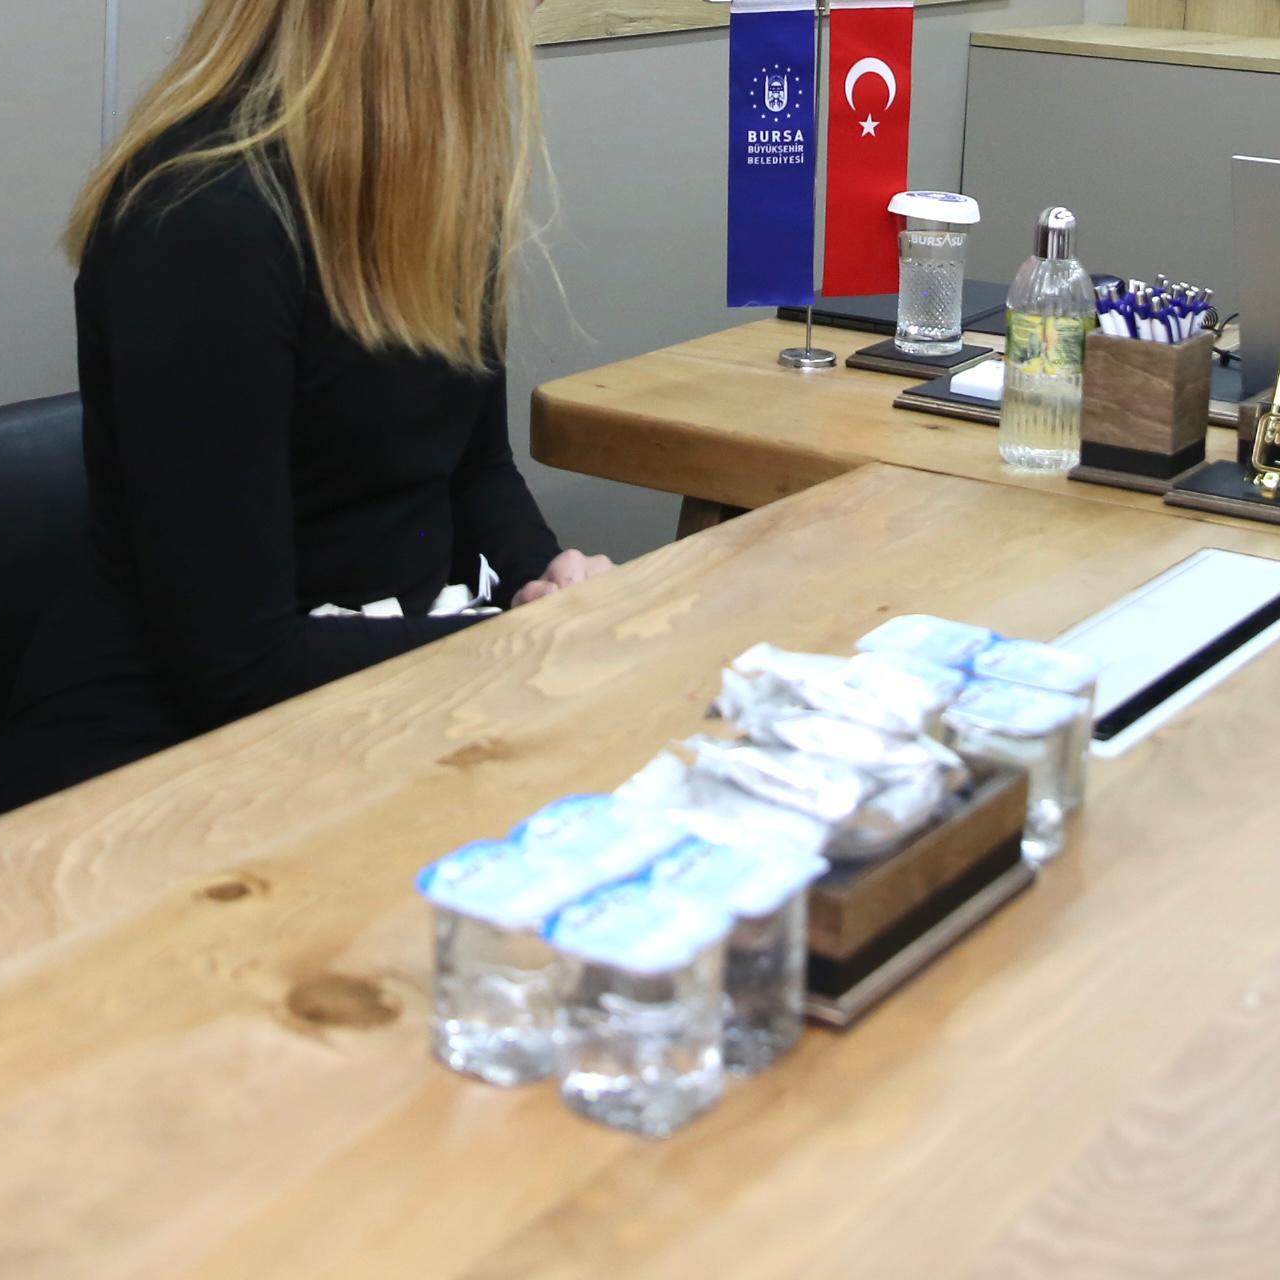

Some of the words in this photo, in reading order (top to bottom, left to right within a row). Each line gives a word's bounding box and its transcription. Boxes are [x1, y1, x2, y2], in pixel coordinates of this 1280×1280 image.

[748, 130, 804, 142] BURSA
[748, 143, 804, 153] BÜYÜKŞEHİR
[748, 153, 804, 164] BELEDİYESİ
